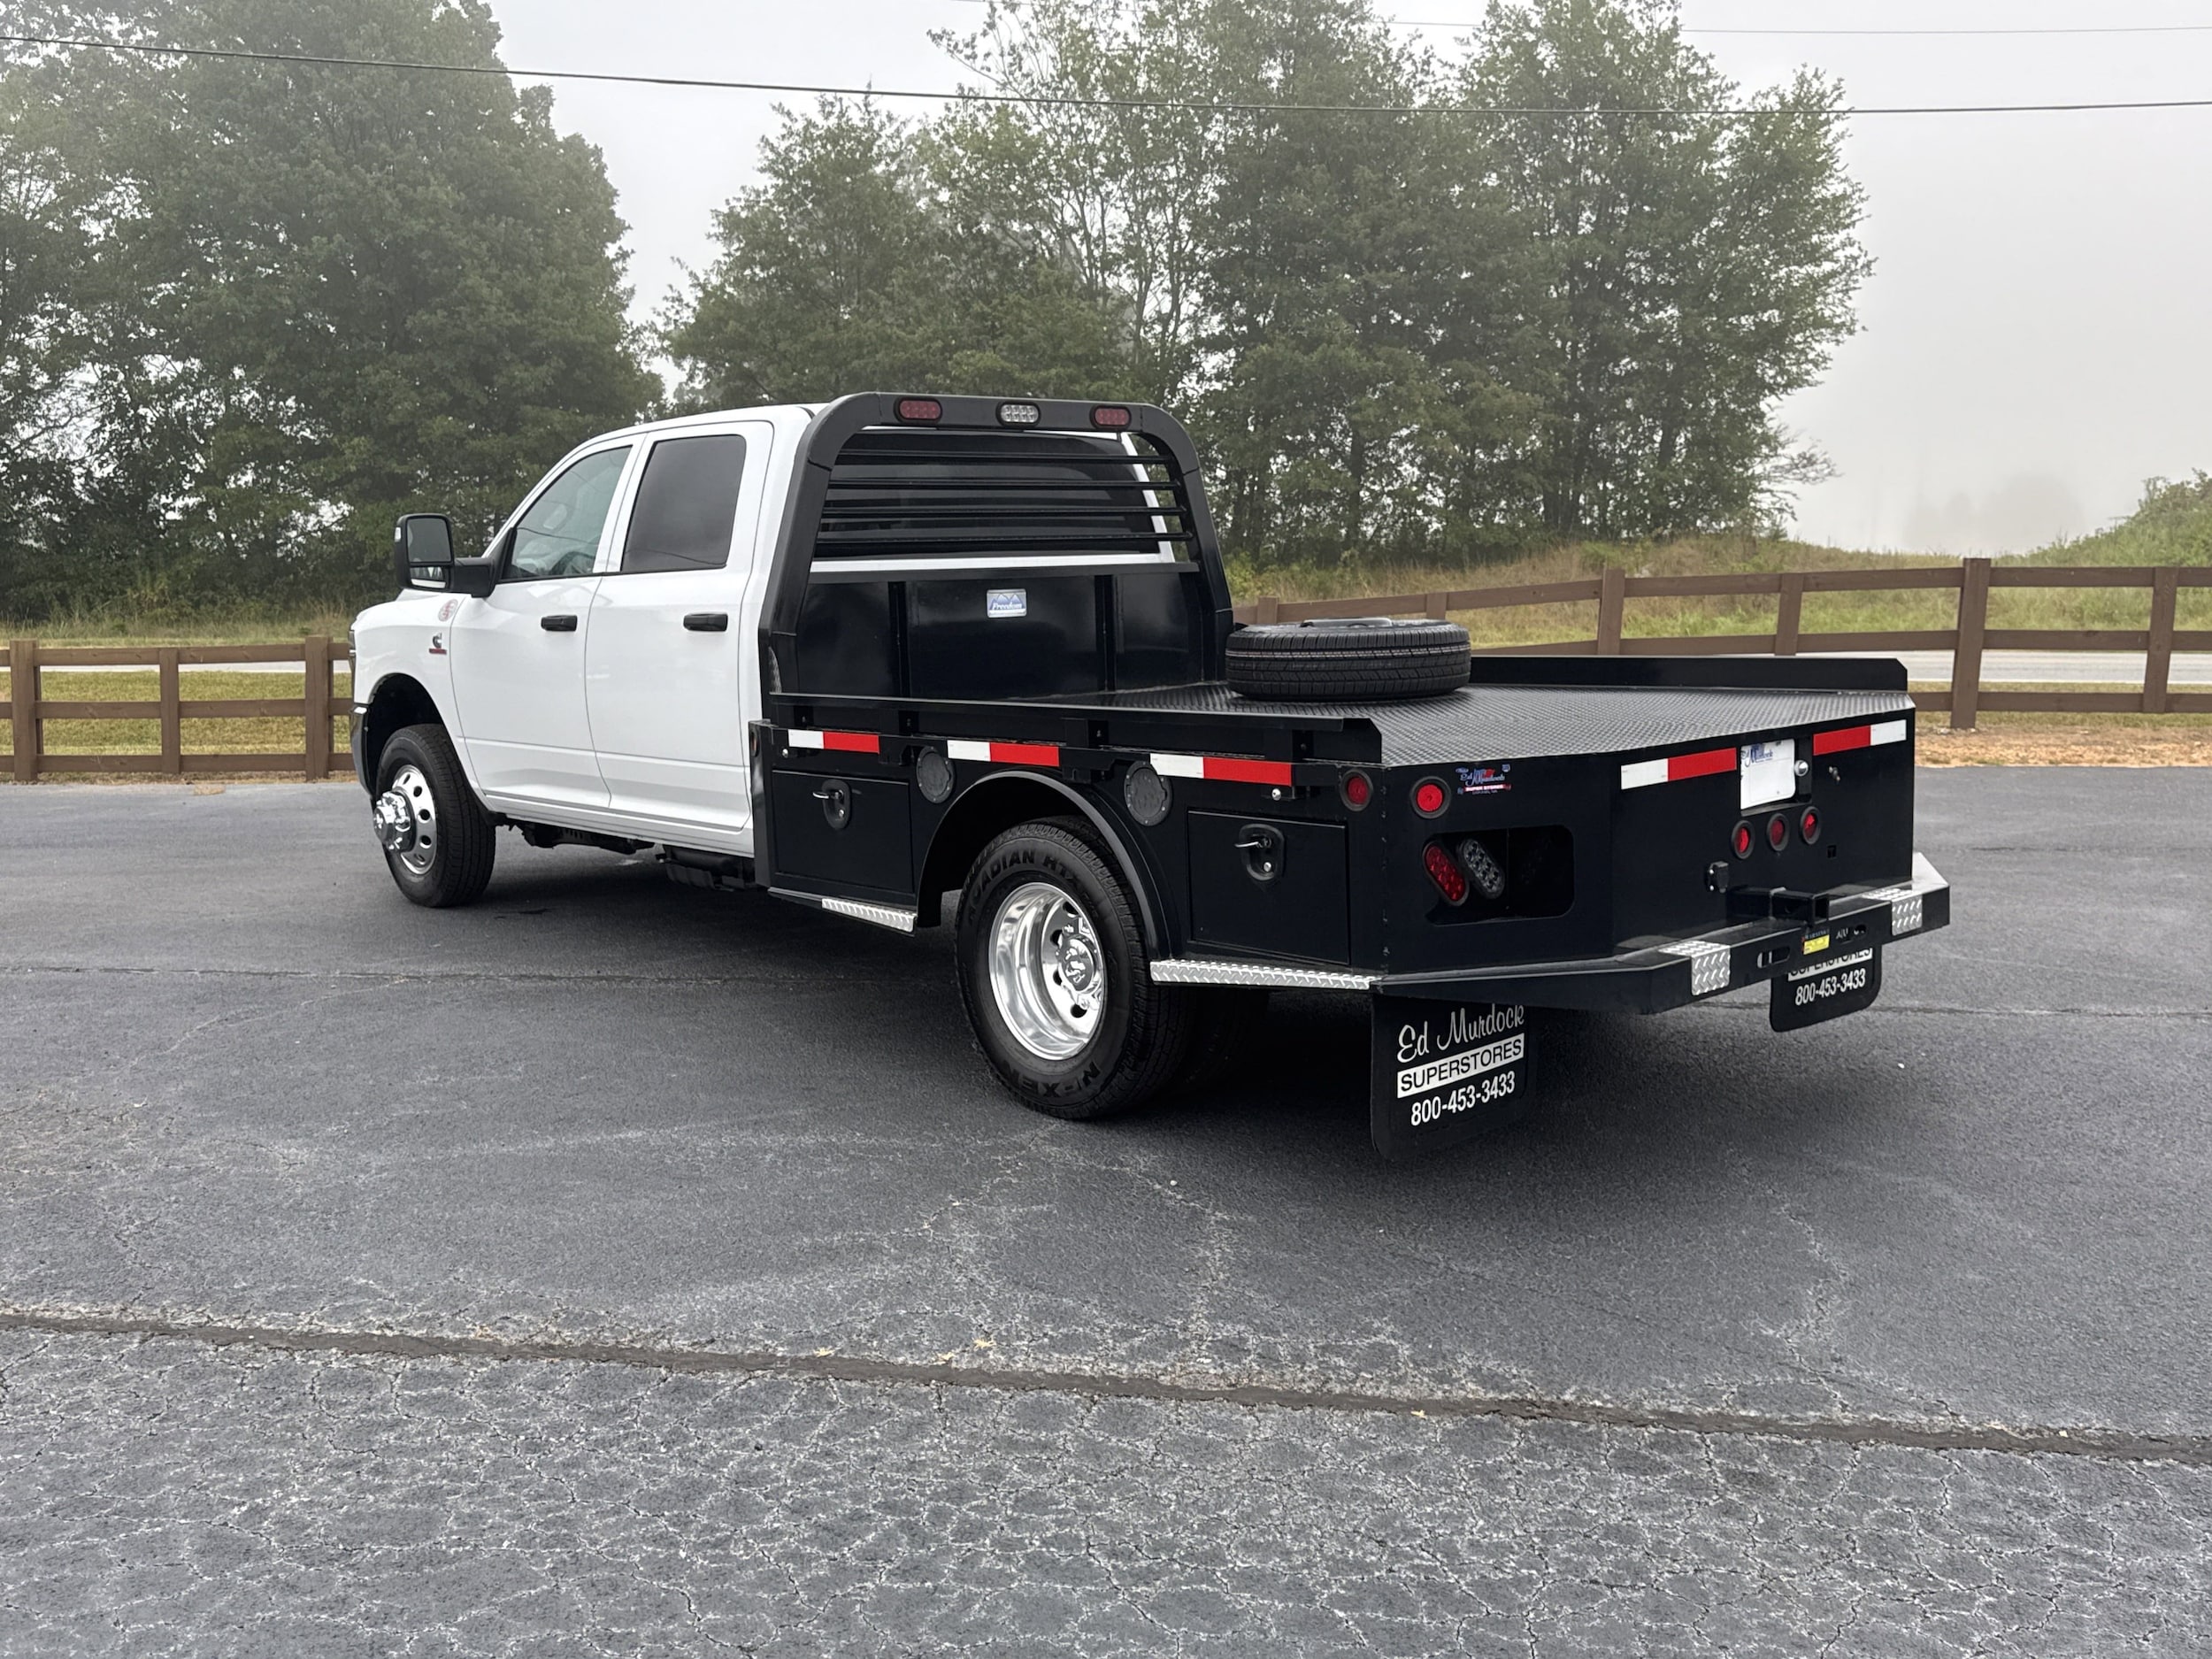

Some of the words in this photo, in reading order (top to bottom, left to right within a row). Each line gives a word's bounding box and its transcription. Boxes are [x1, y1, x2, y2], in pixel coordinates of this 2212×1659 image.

[1795, 968, 1866, 1005] 800-453-3433
[1397, 1021, 1429, 1063] Ed
[1437, 1003, 1525, 1050] Murdock
[1401, 1039, 1522, 1092] SUPERSTORES
[1410, 1071, 1515, 1125] 800-453-3433
